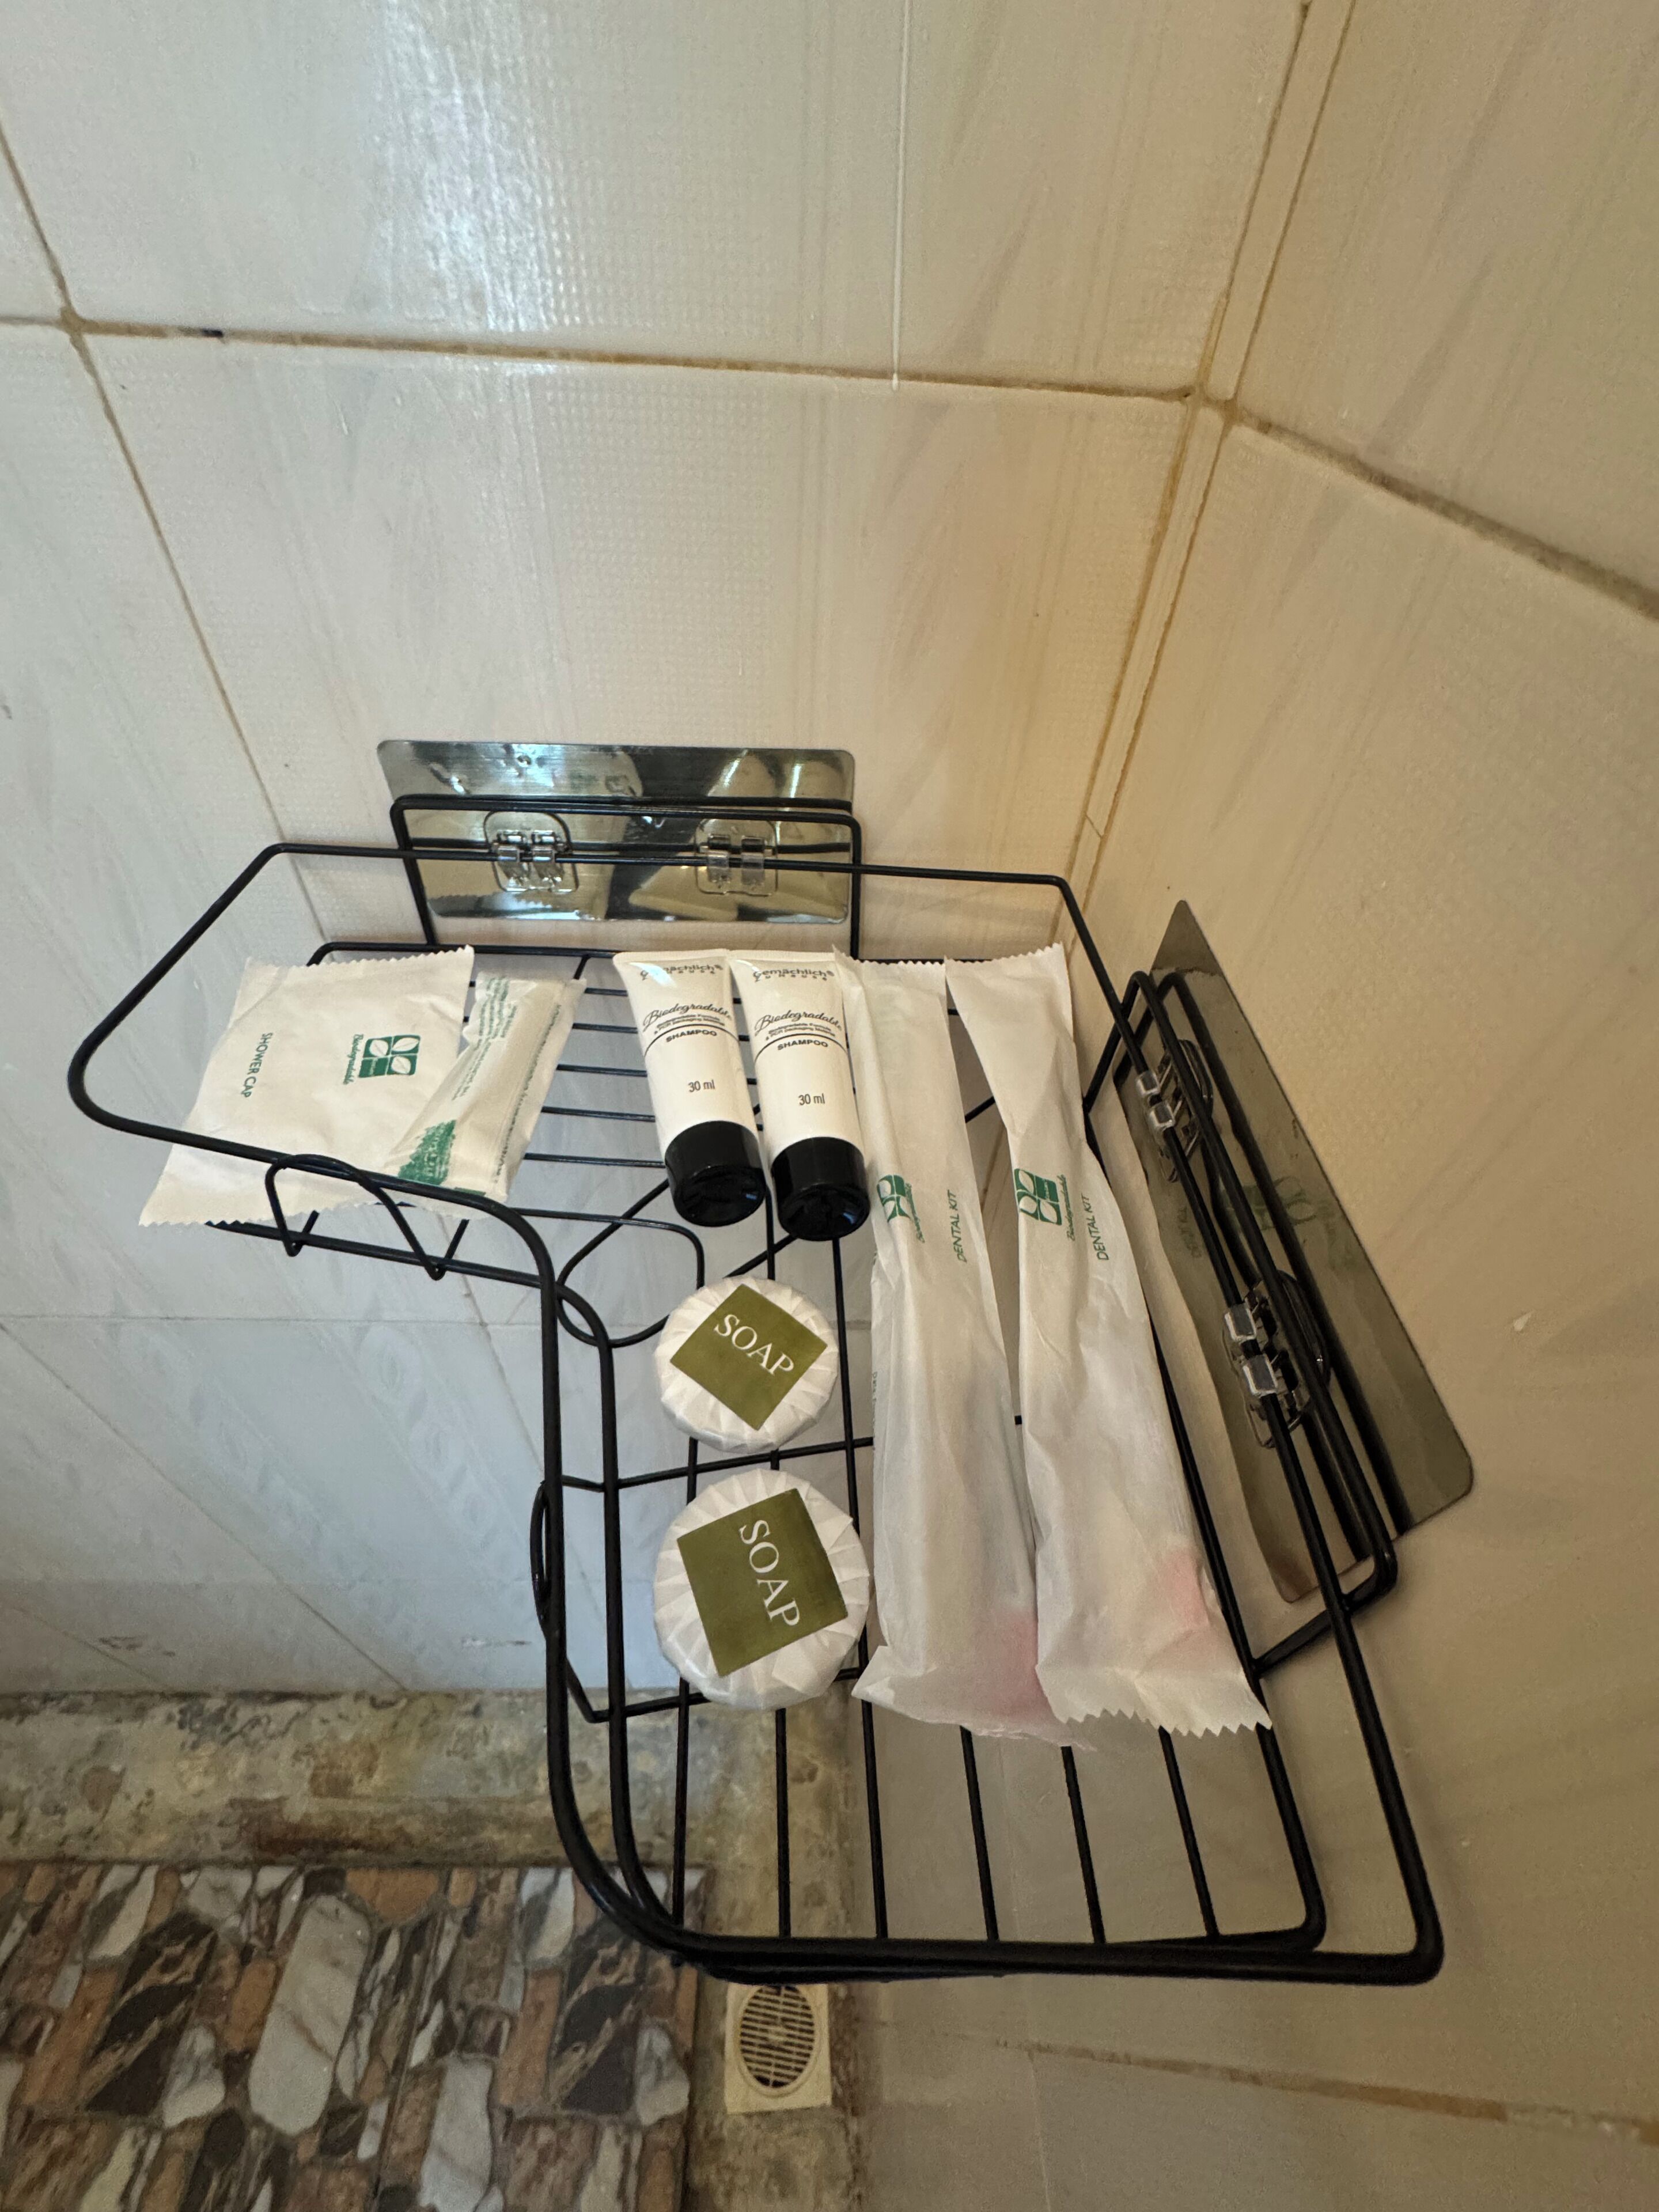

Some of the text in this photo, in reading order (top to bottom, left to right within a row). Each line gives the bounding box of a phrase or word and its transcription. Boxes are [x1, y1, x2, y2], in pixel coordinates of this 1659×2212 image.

[642, 1003, 732, 1033] Biodegradable
[754, 1010, 842, 1036] Biodegradable
[666, 1029, 717, 1042] SHAMPOO
[777, 1039, 828, 1051] SHAMPOO
[241, 1032, 273, 1098] SHOWER CAP
[688, 1080, 715, 1093] 30 ml
[798, 1093, 825, 1106] 30 ml
[947, 1189, 968, 1263] DENTAL KIT
[1081, 1192, 1109, 1261] DENTAL KIT
[714, 1314, 794, 1376] SOAP
[738, 1520, 800, 1628] SOAP
